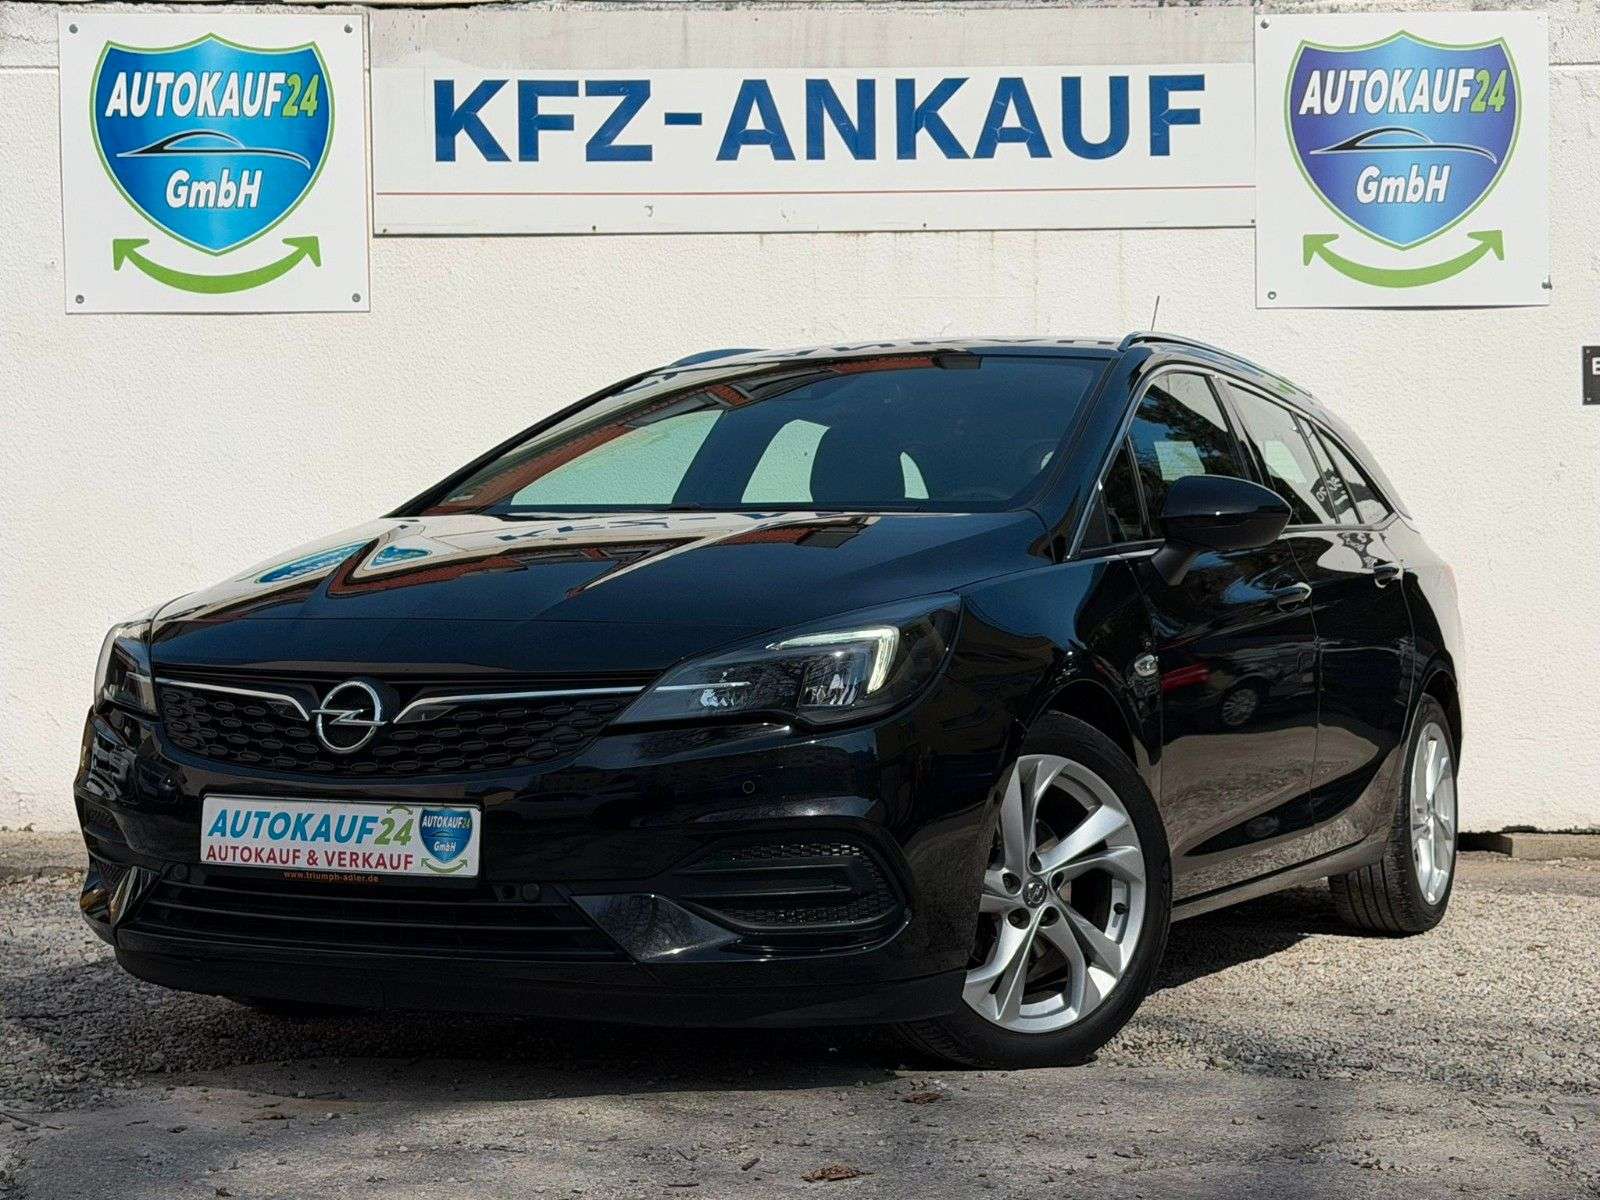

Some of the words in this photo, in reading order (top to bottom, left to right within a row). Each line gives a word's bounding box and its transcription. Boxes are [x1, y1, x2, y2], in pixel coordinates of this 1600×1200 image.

[105, 71, 319, 118] AUTOKAUF24
[1299, 67, 1508, 115] AUTOKAUF24
[433, 74, 1205, 163] KFZ-ANKAUF
[165, 168, 263, 209] GmbH
[1356, 164, 1451, 204] GmbH
[207, 808, 414, 846] AUTOKAUF24
[422, 815, 471, 829] AUTOKAUF24
[205, 845, 301, 866] AUTOKAUF
[306, 850, 319, 867] &
[325, 850, 414, 871] VERKAUF
[433, 841, 457, 852] GmbH
[283, 870, 379, 883] www.triumph-adler.de
